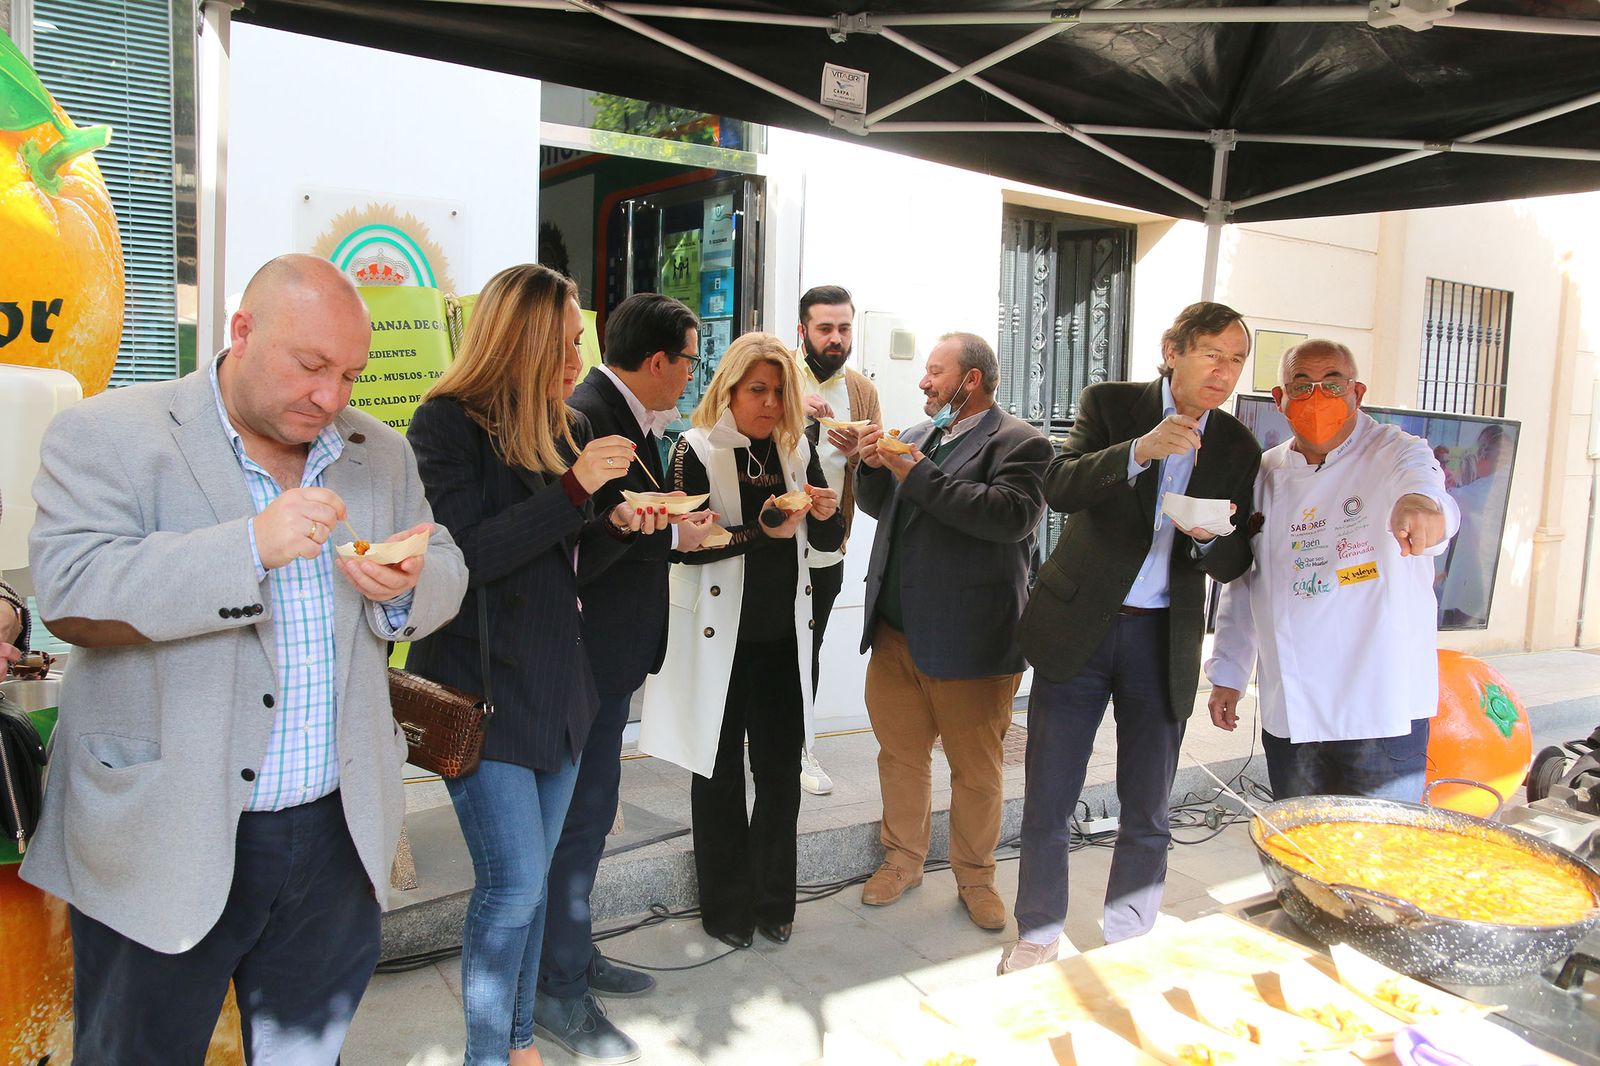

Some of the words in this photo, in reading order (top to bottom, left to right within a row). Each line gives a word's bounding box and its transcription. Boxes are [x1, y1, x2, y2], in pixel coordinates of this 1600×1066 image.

[414, 319, 430, 330] DE
[384, 371, 423, 381] MUSLOS
[358, 398, 373, 407] DE
[374, 395, 408, 406] CALDO
[1291, 519, 1327, 533] SABORES
[1346, 540, 1369, 550] Sabor
[1341, 546, 1375, 559] Granada
